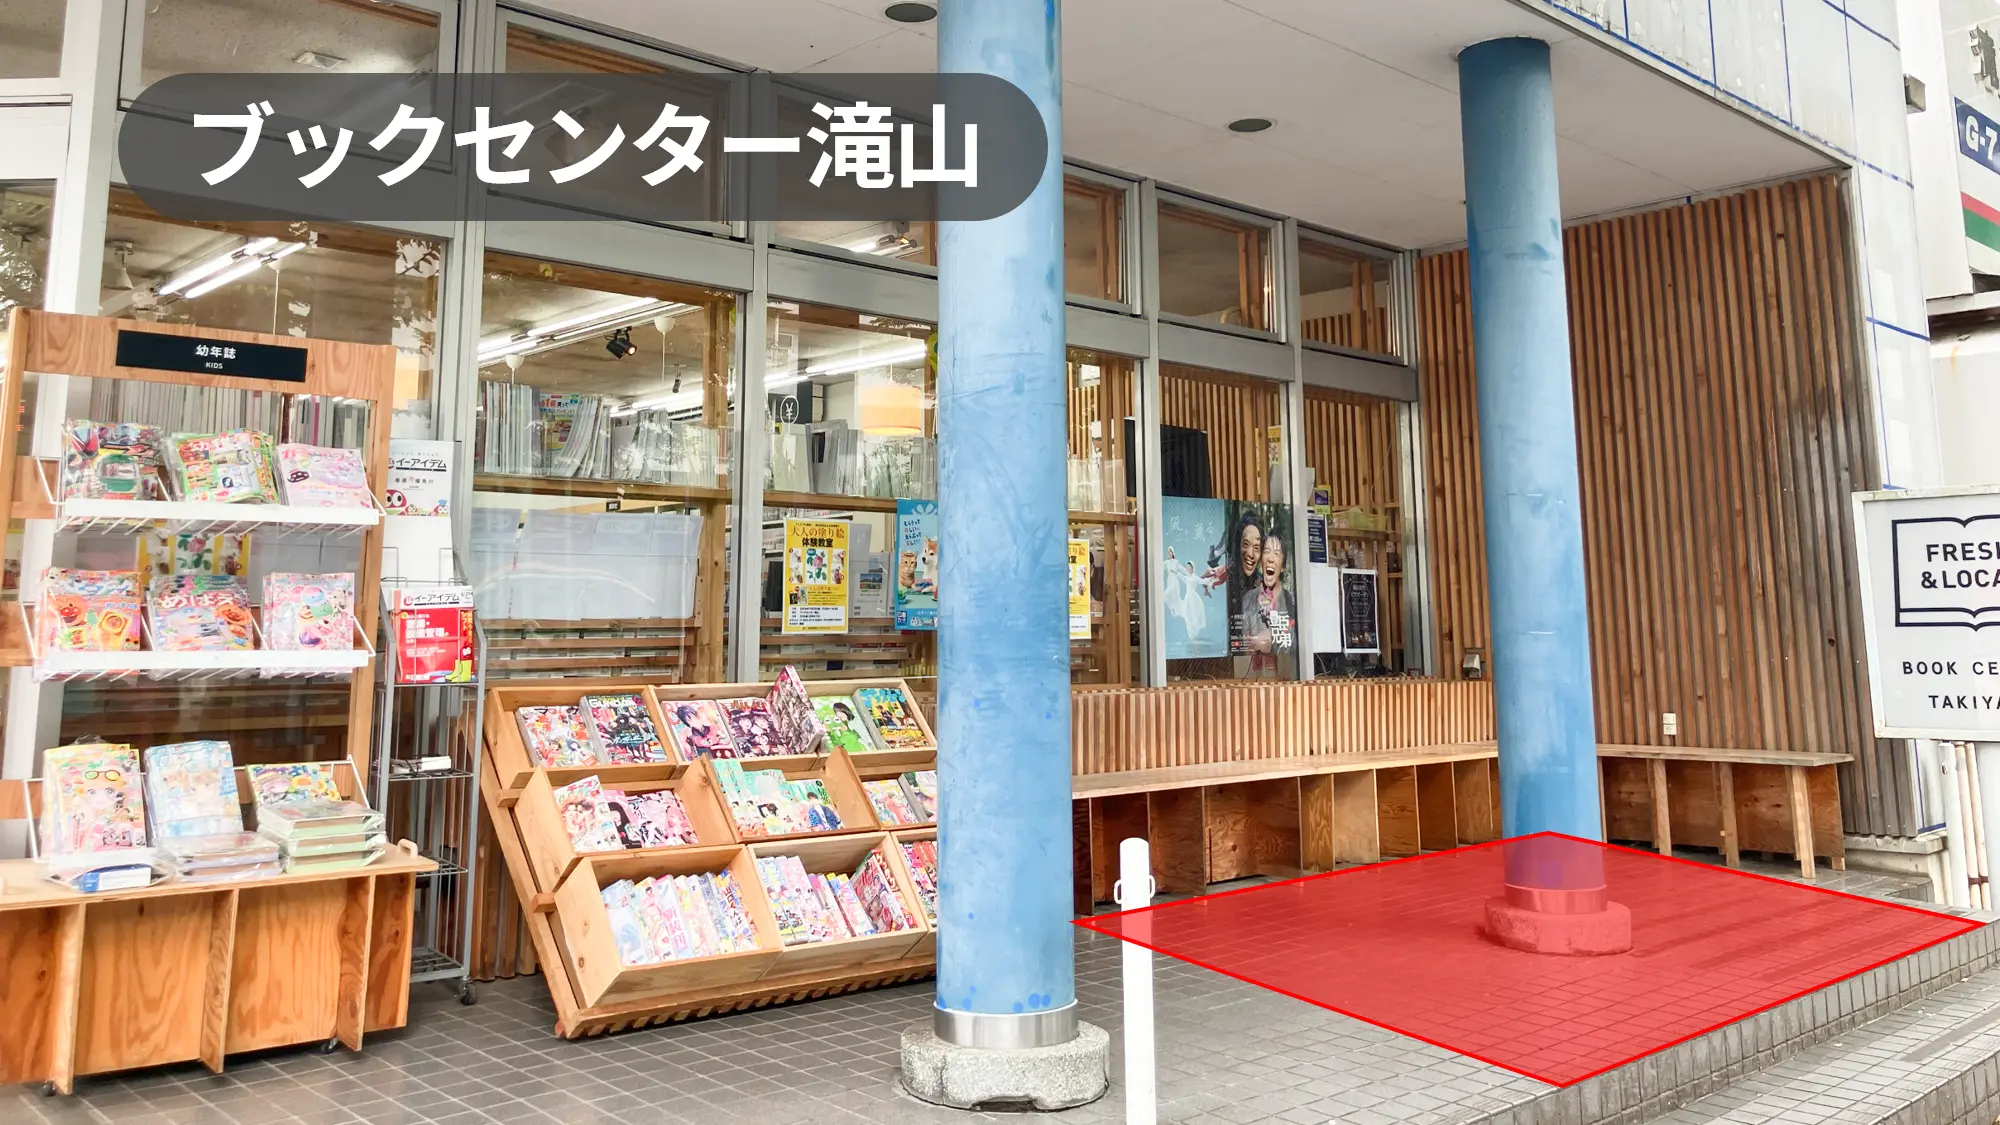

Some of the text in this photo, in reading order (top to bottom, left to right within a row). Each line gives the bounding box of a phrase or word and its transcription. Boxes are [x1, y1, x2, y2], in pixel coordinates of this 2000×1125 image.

[195, 344, 237, 359] 幼年誌
[791, 526, 845, 539] 大人の塗り絵
[802, 537, 834, 547] 体験教室
[1902, 661, 1958, 675] BOOK
